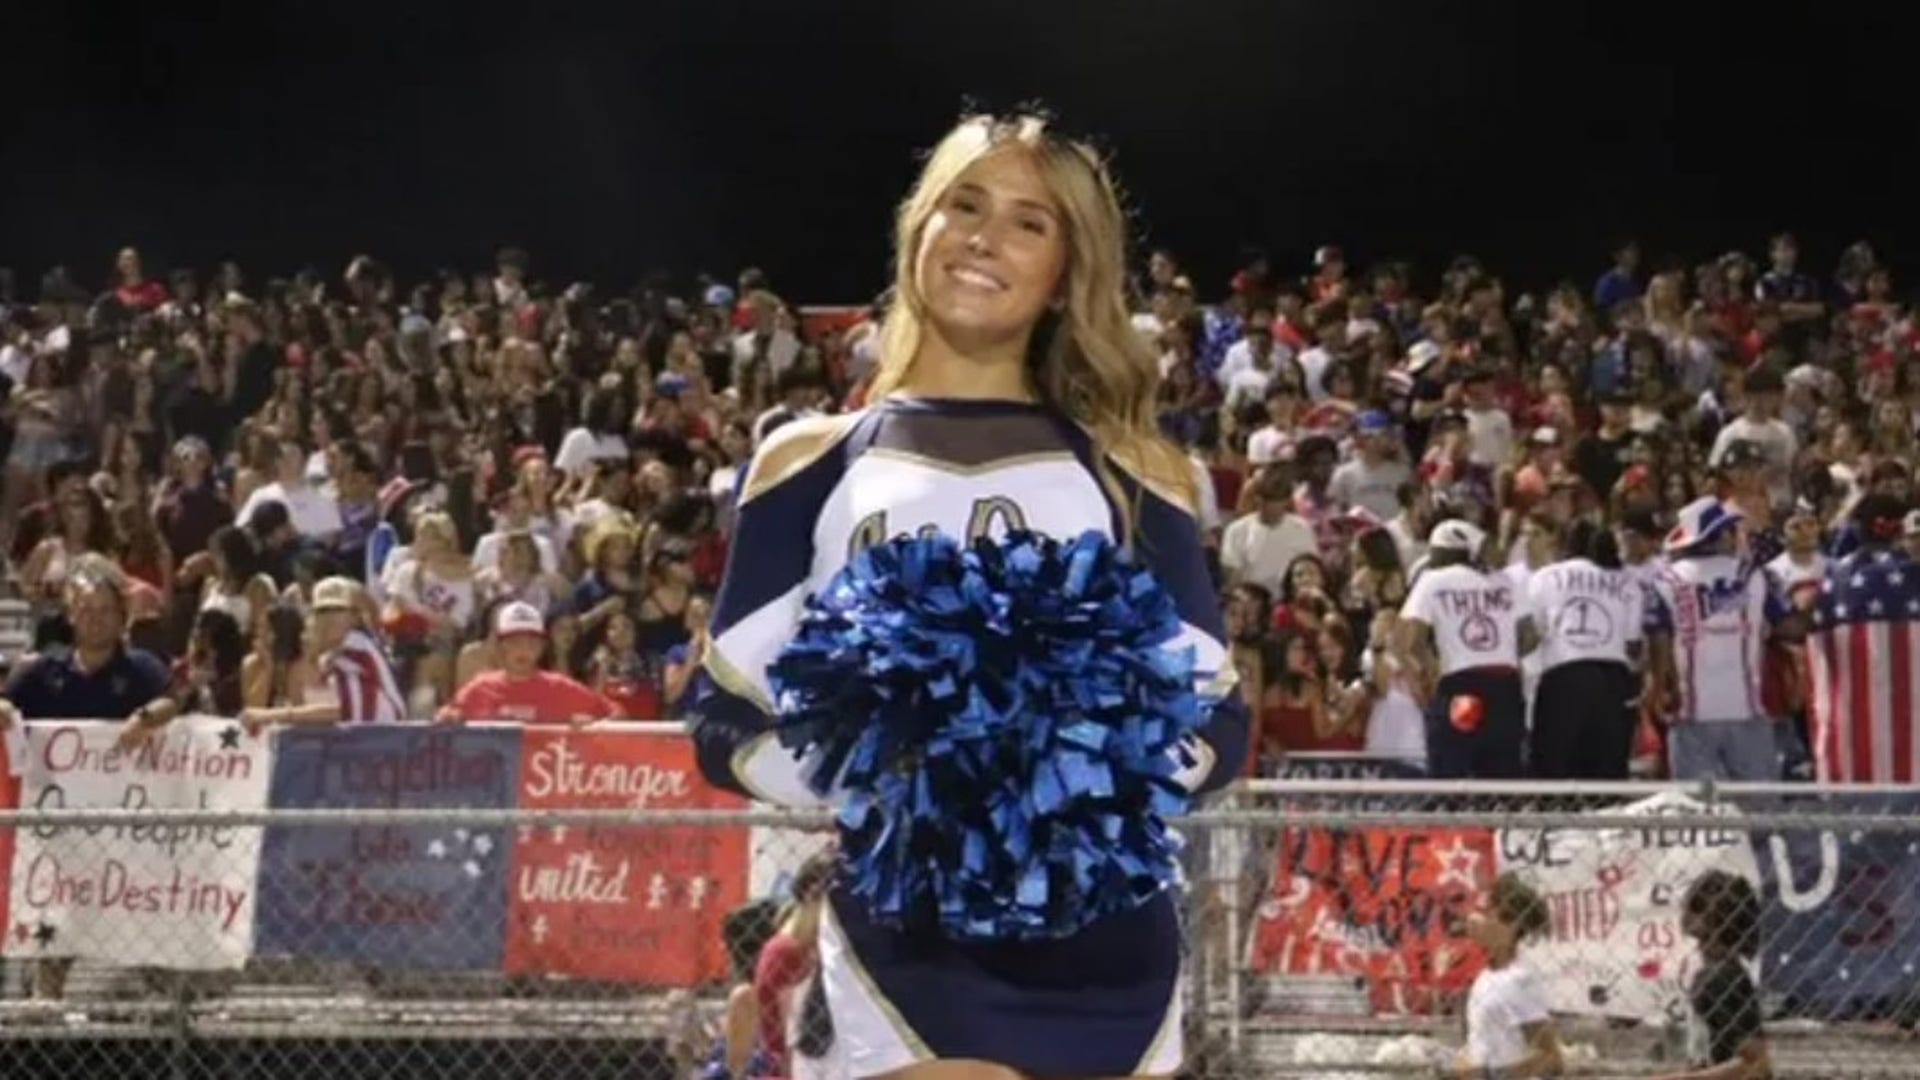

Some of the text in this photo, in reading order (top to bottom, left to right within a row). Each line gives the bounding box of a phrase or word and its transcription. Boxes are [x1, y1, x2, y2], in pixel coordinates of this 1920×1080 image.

[1435, 587, 1512, 617] THING
[1552, 569, 1642, 603] THING
[43, 726, 253, 779] One Nation
[525, 737, 690, 807] Stronger
[519, 852, 629, 903] united
[1637, 921, 1675, 949] as
